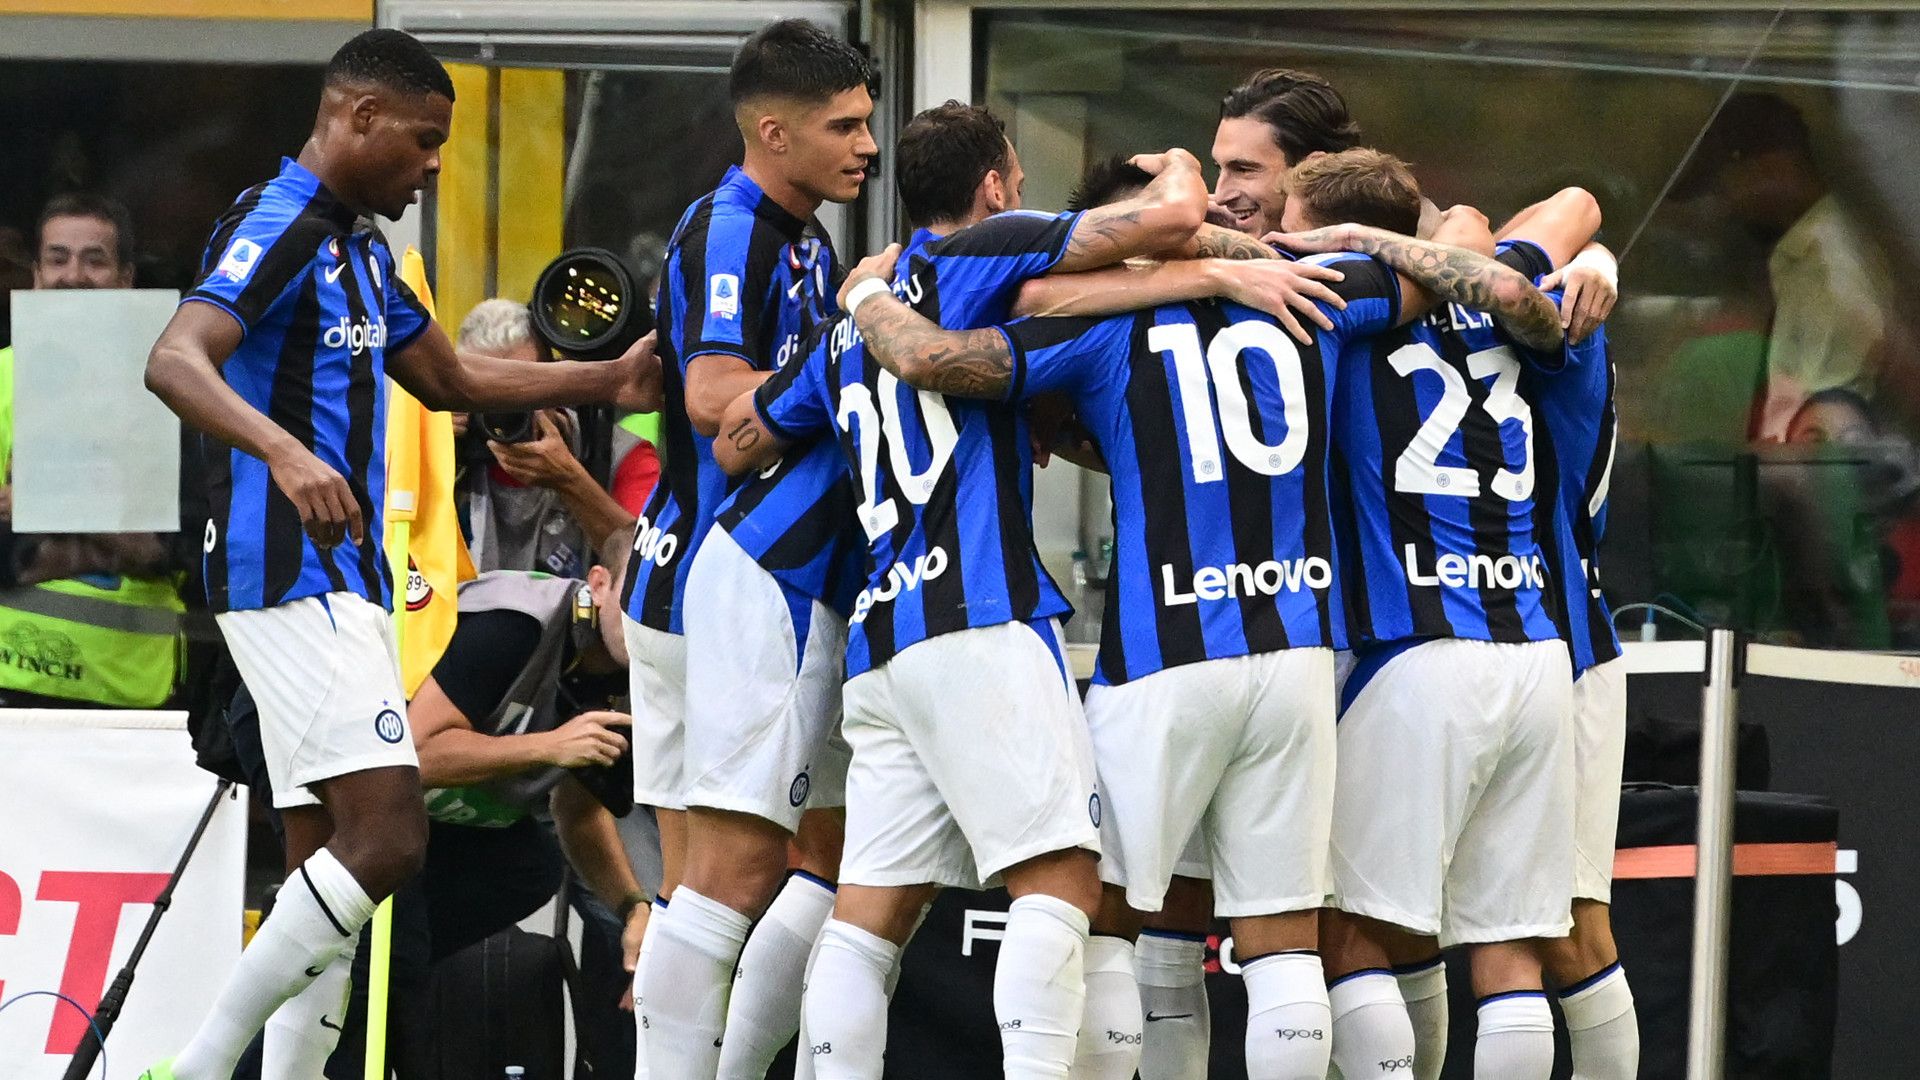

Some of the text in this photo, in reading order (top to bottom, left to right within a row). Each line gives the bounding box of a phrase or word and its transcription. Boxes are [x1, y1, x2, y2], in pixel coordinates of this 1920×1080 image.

[1148, 319, 1309, 483] 10
[728, 418, 761, 451] 10
[1386, 342, 1535, 502] 23
[1161, 556, 1333, 607] Lenovo
[1106, 1030, 1142, 1045] 1908
[1275, 1029, 1323, 1041] 1908
[1377, 1055, 1412, 1072] 1908
